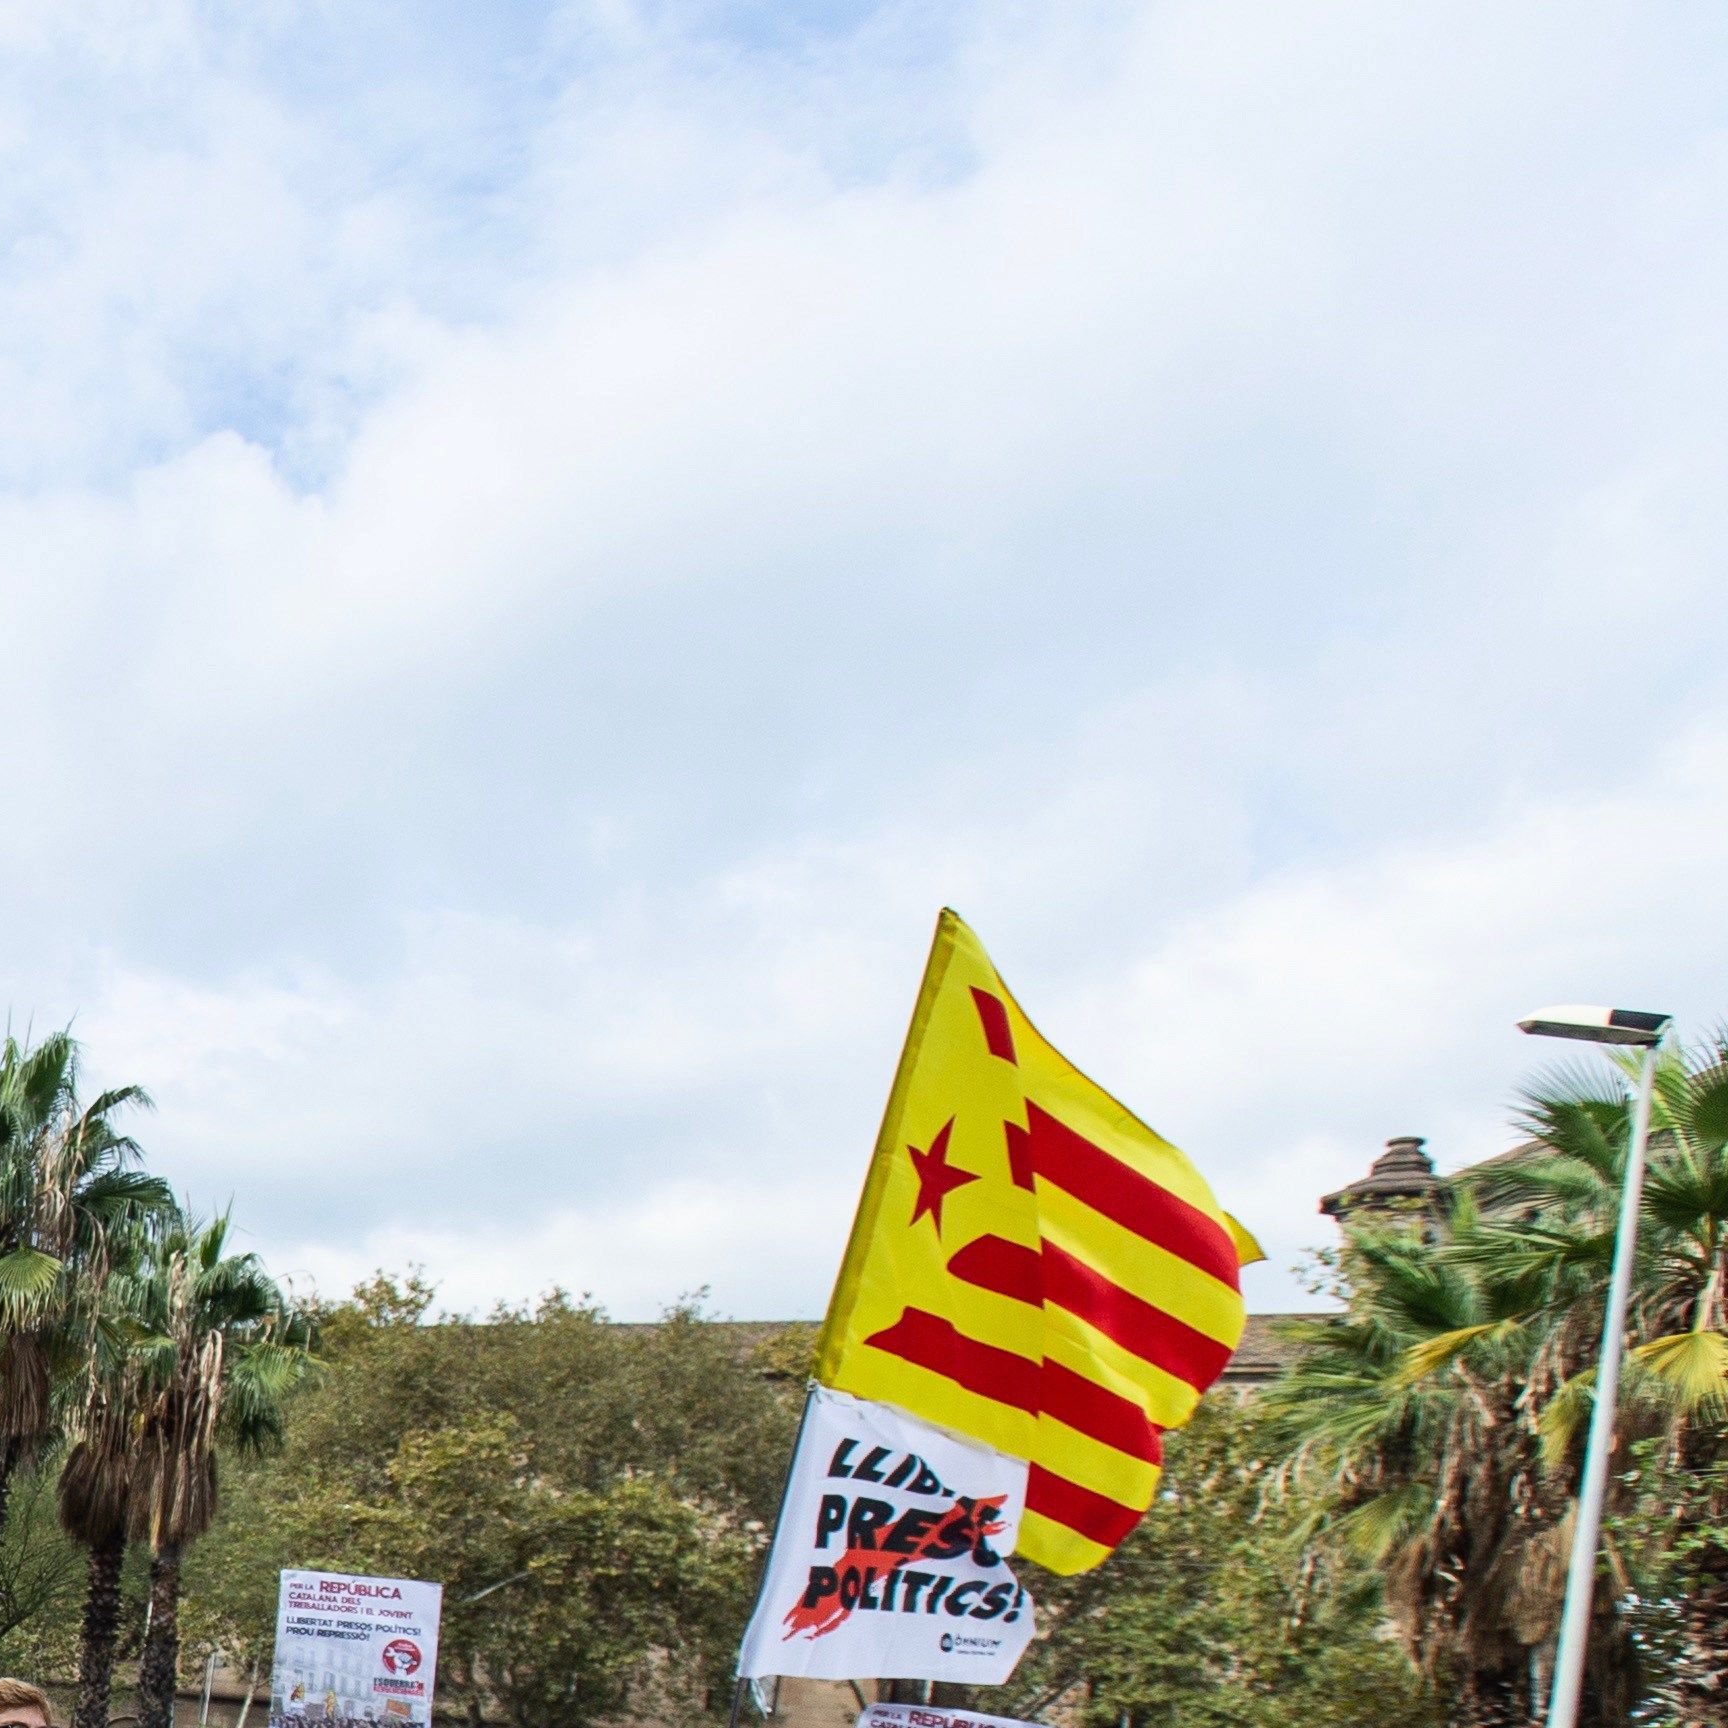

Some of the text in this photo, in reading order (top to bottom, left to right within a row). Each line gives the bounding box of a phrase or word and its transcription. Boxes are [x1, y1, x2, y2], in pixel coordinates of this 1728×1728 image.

[288, 1592, 361, 1605] CATALANA DELS
[320, 1580, 402, 1600] REPÚBLICA
[801, 1558, 1024, 1624] POLÍTICS!
[288, 1601, 413, 1620] TREBALLADORS JOVENT
[286, 1616, 421, 1636] LLIBERTAT PRESOS POLÍTICS!
[286, 1627, 370, 1641] PROU REPRESSIÓ!
